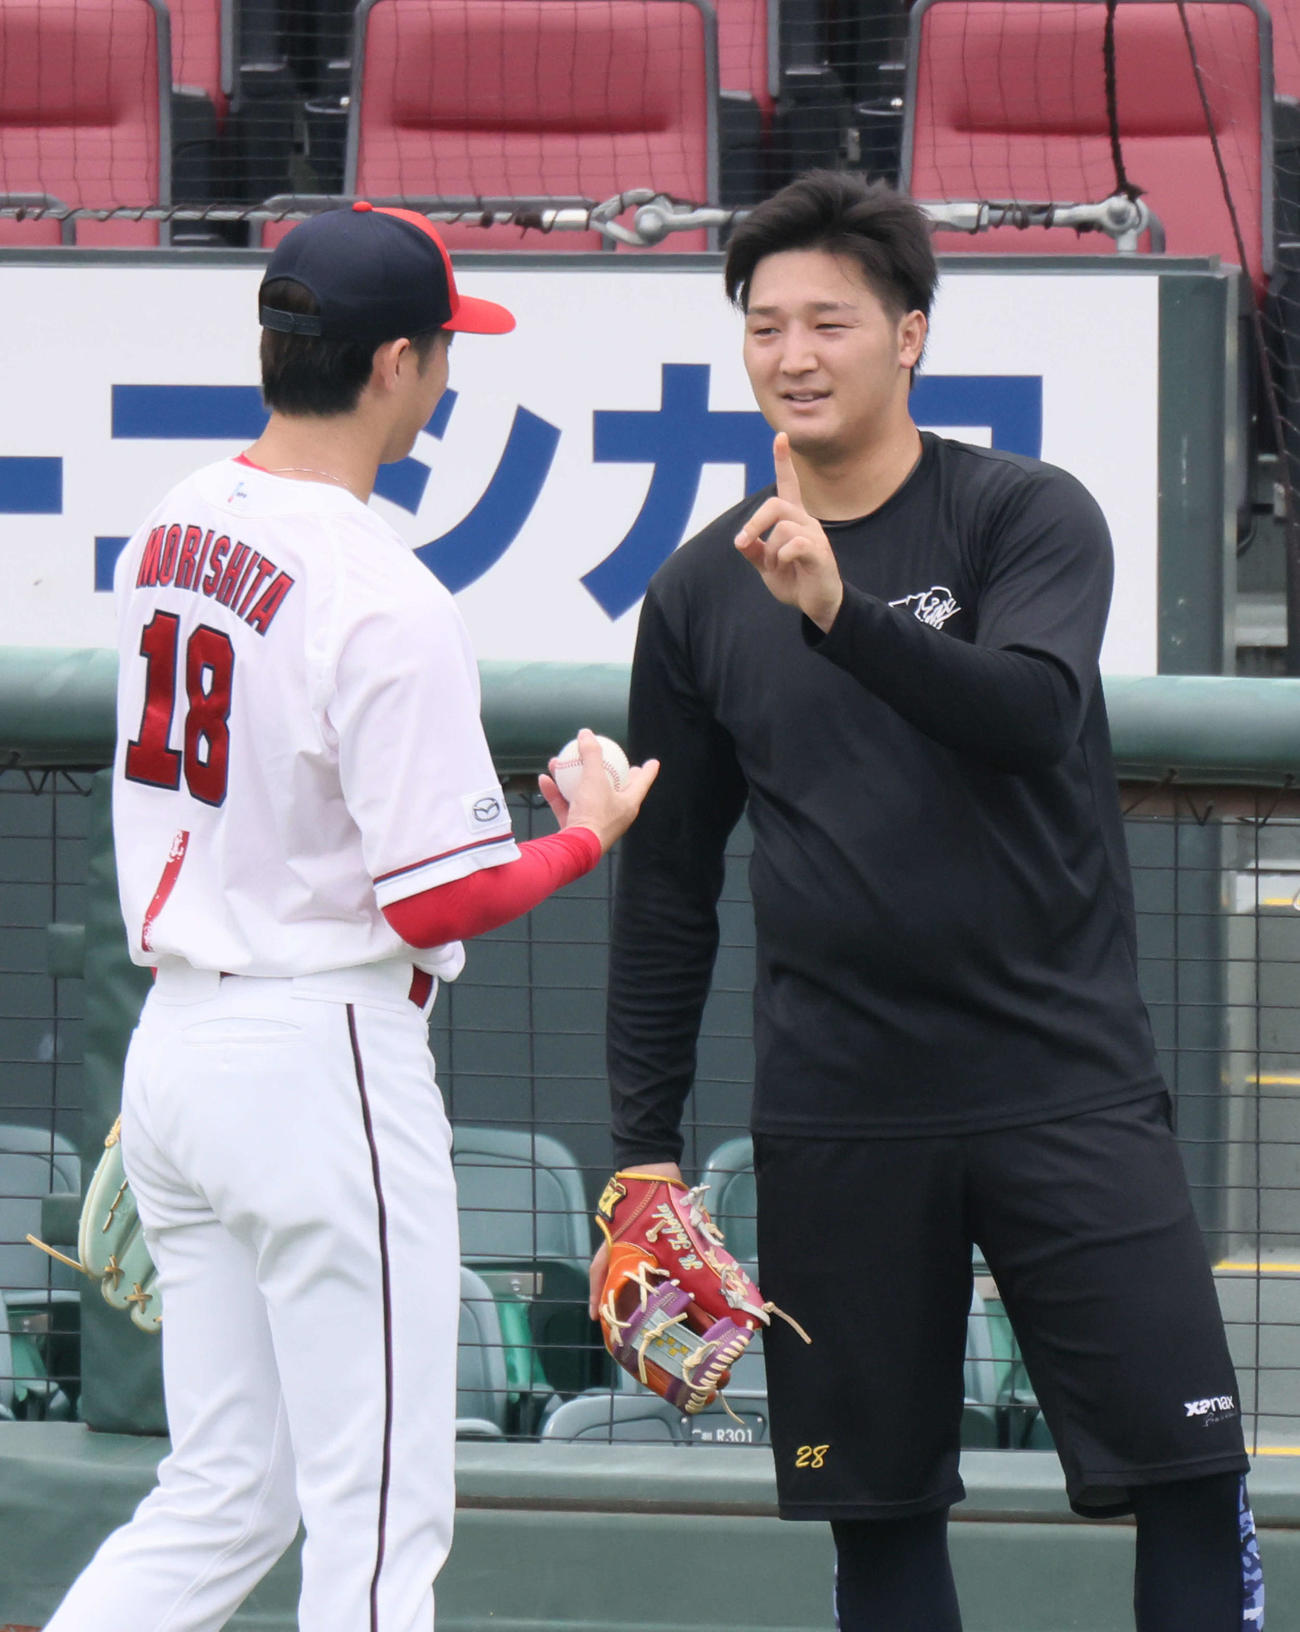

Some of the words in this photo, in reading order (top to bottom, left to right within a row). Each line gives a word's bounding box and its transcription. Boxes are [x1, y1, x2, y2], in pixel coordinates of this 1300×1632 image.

[135, 523, 295, 637] MORISHITA
[125, 608, 235, 808] 18
[795, 1444, 830, 1469] 28
